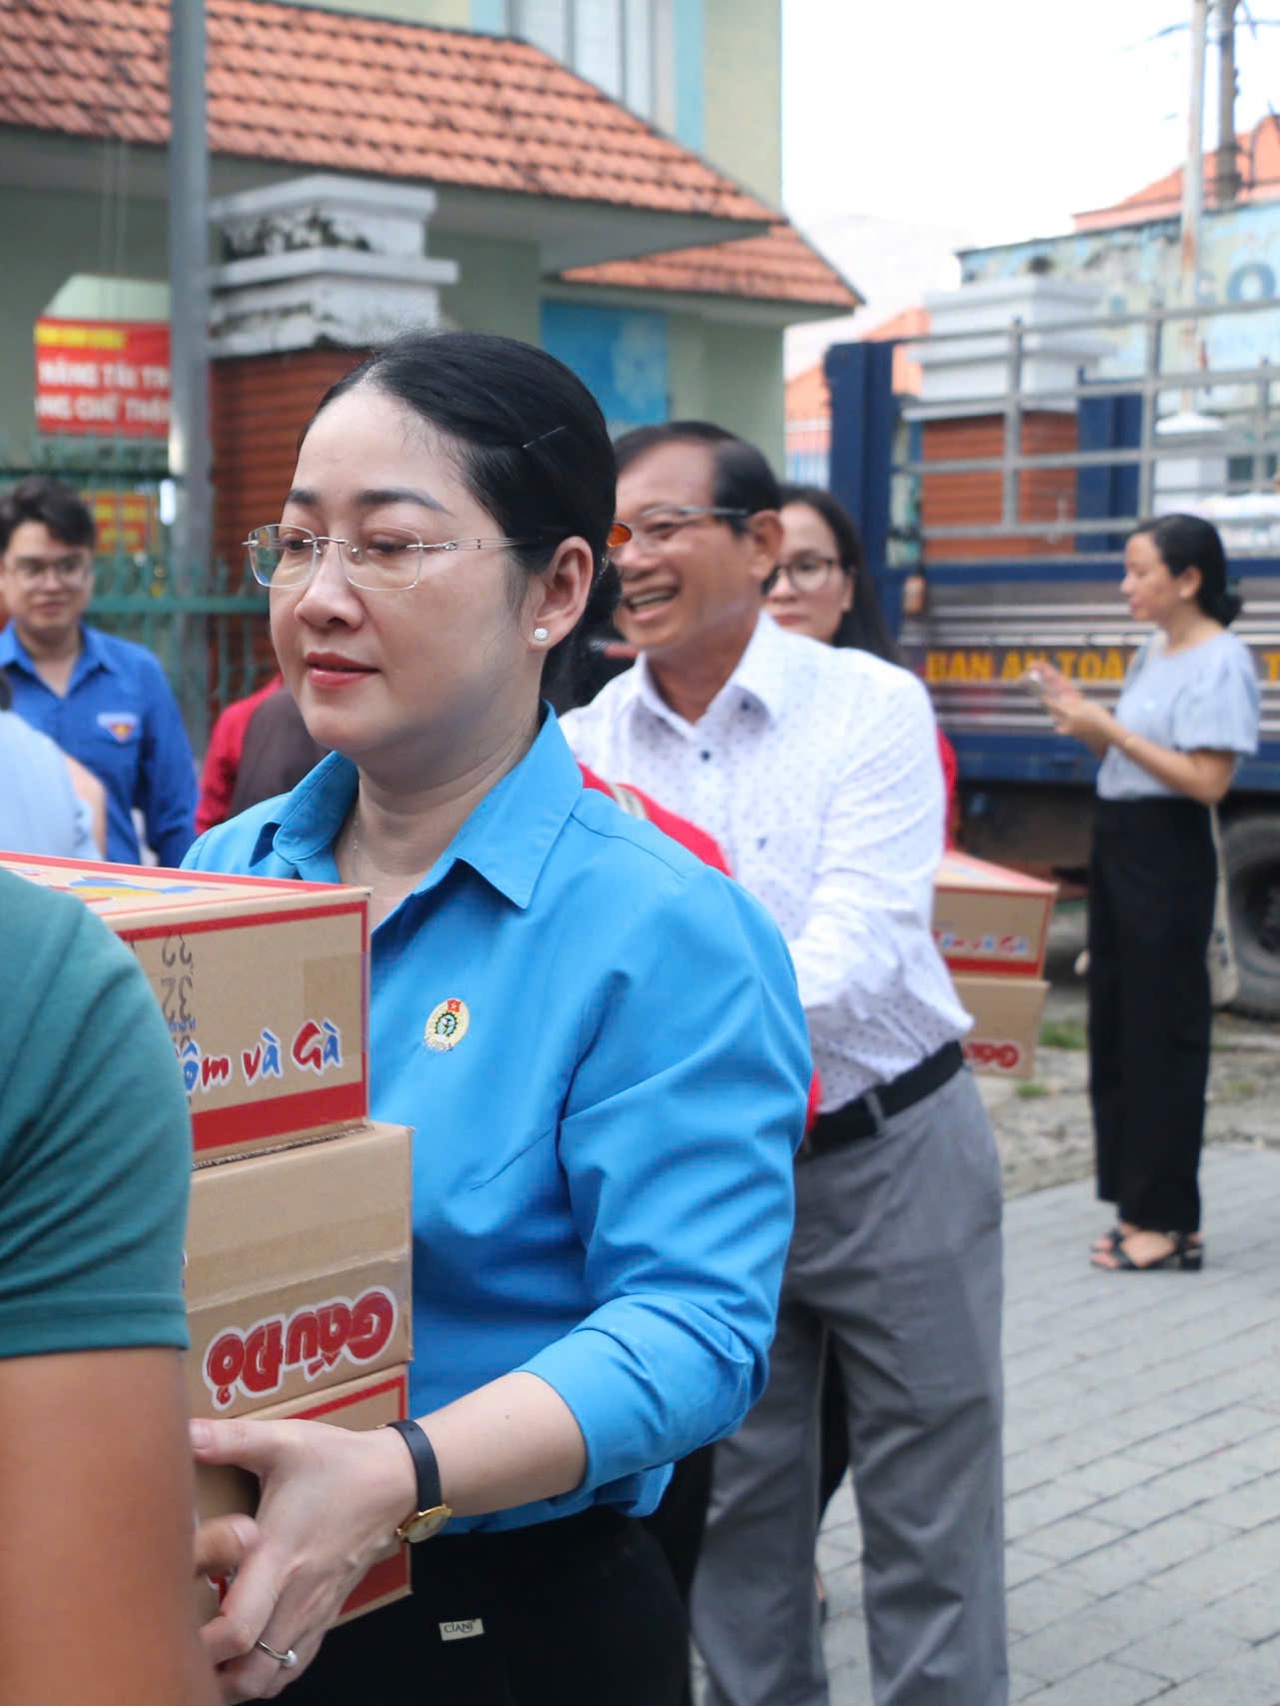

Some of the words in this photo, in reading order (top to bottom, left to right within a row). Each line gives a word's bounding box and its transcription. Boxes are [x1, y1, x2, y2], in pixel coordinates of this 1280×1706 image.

[175, 1042, 229, 1091] ôm
[243, 1031, 280, 1080] và
[293, 1021, 340, 1070] Gà
